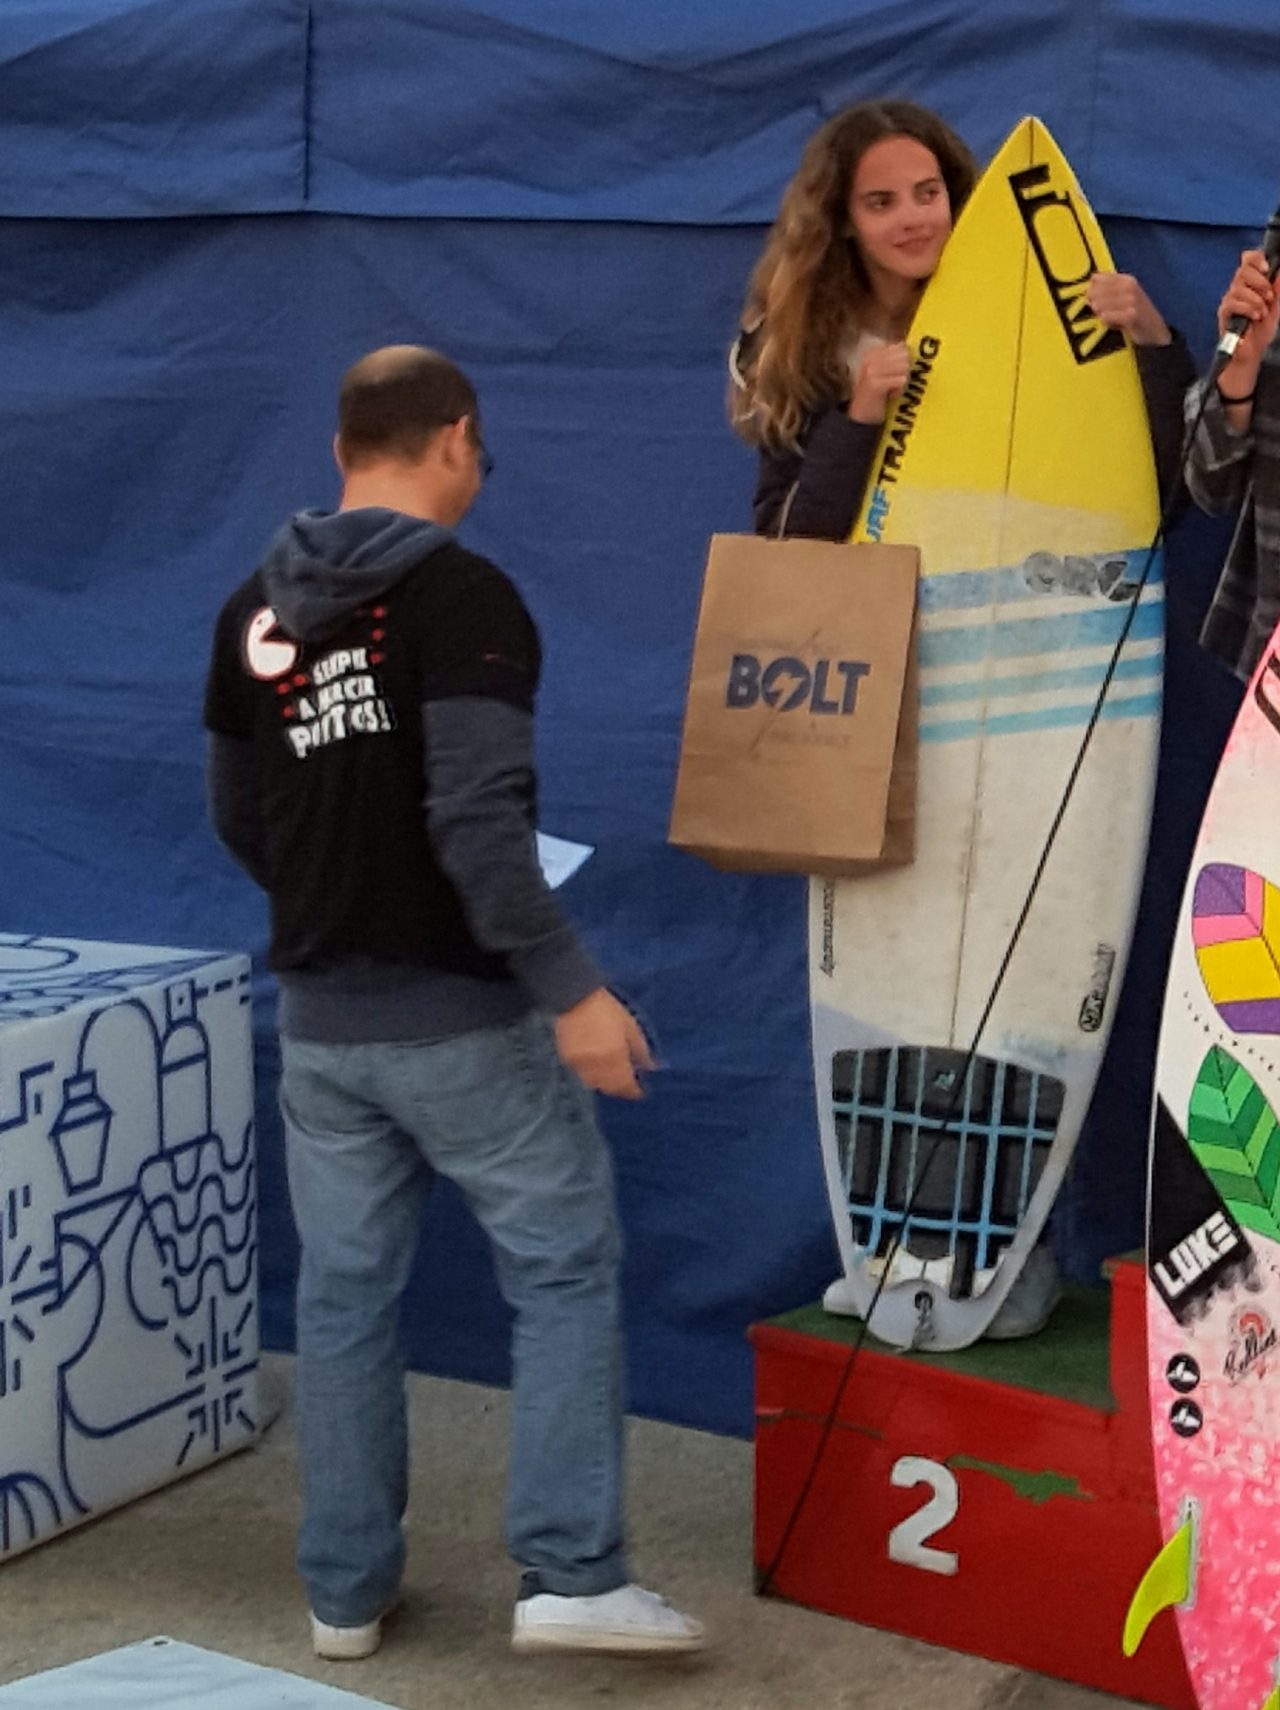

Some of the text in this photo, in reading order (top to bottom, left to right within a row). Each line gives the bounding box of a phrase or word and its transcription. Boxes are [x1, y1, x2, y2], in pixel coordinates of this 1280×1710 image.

[726, 654, 872, 716] BOLT
[1155, 1210, 1239, 1298] LUKE
[889, 1455, 960, 1577] 2
